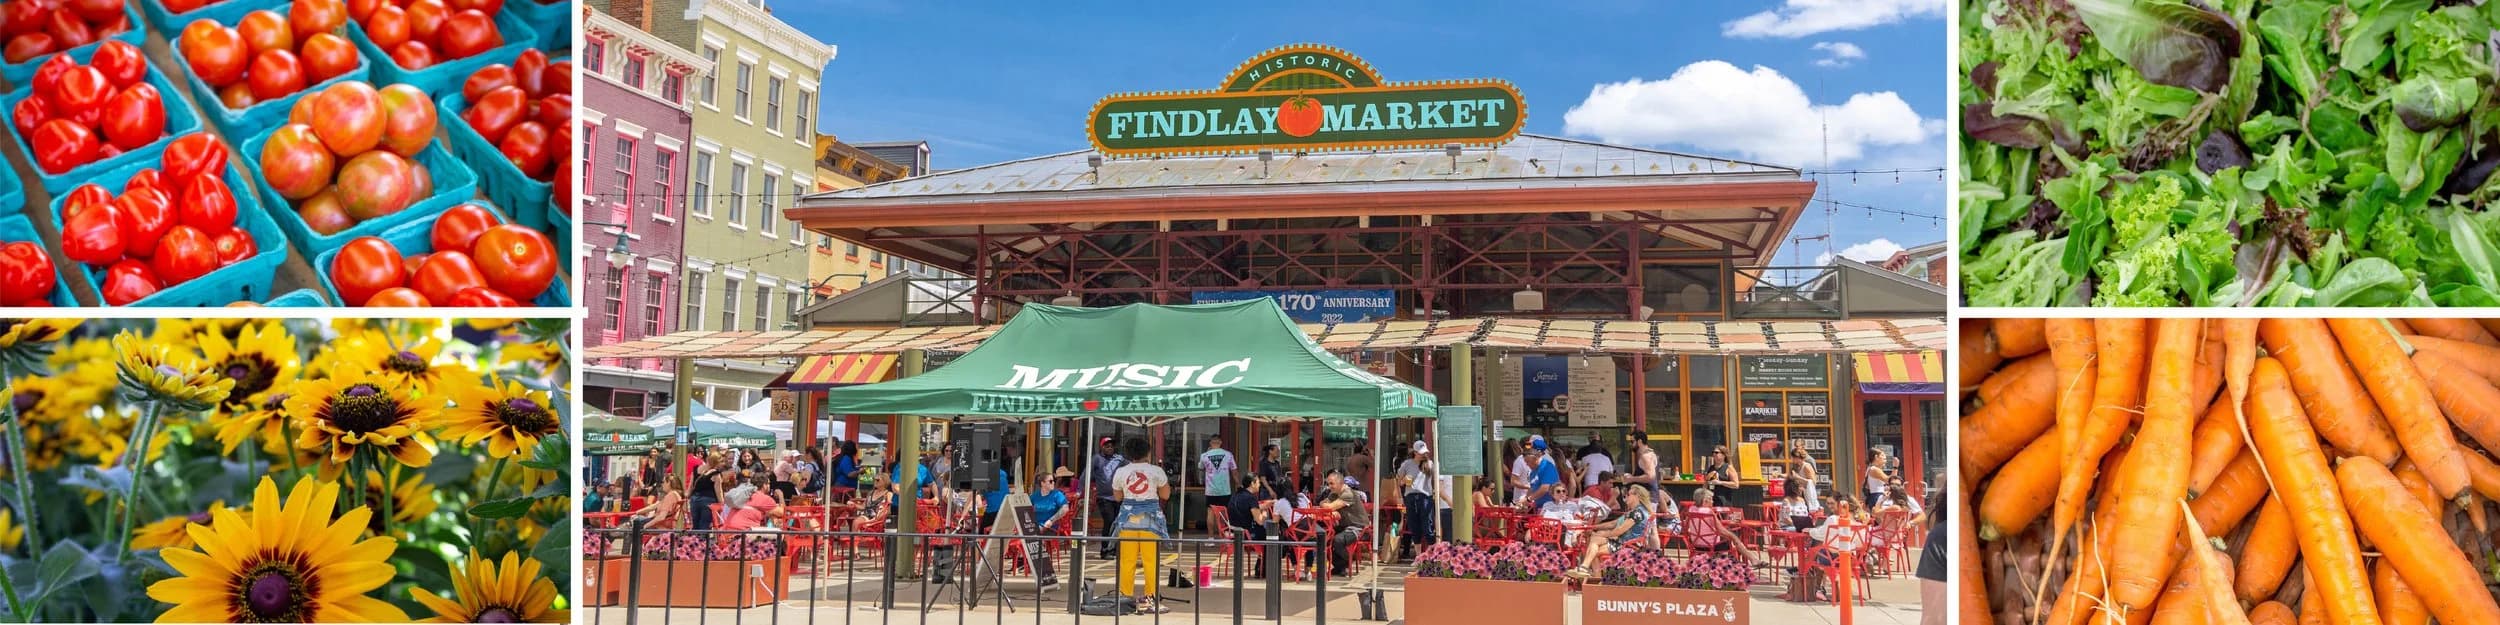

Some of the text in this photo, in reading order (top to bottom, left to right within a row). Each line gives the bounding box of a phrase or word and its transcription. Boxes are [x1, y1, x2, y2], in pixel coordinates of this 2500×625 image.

[1249, 55, 1356, 82] HISTORIC
[1107, 98, 1505, 139] FINDLAY MARKET
[1323, 297, 1391, 308] ANNIVERSARY
[1321, 313, 1344, 323] 2022
[994, 357, 1252, 390] MUSIC
[969, 389, 1223, 412] FINDLAY MARKET
[1597, 599, 1719, 617] BUNNY'S PLAZA
